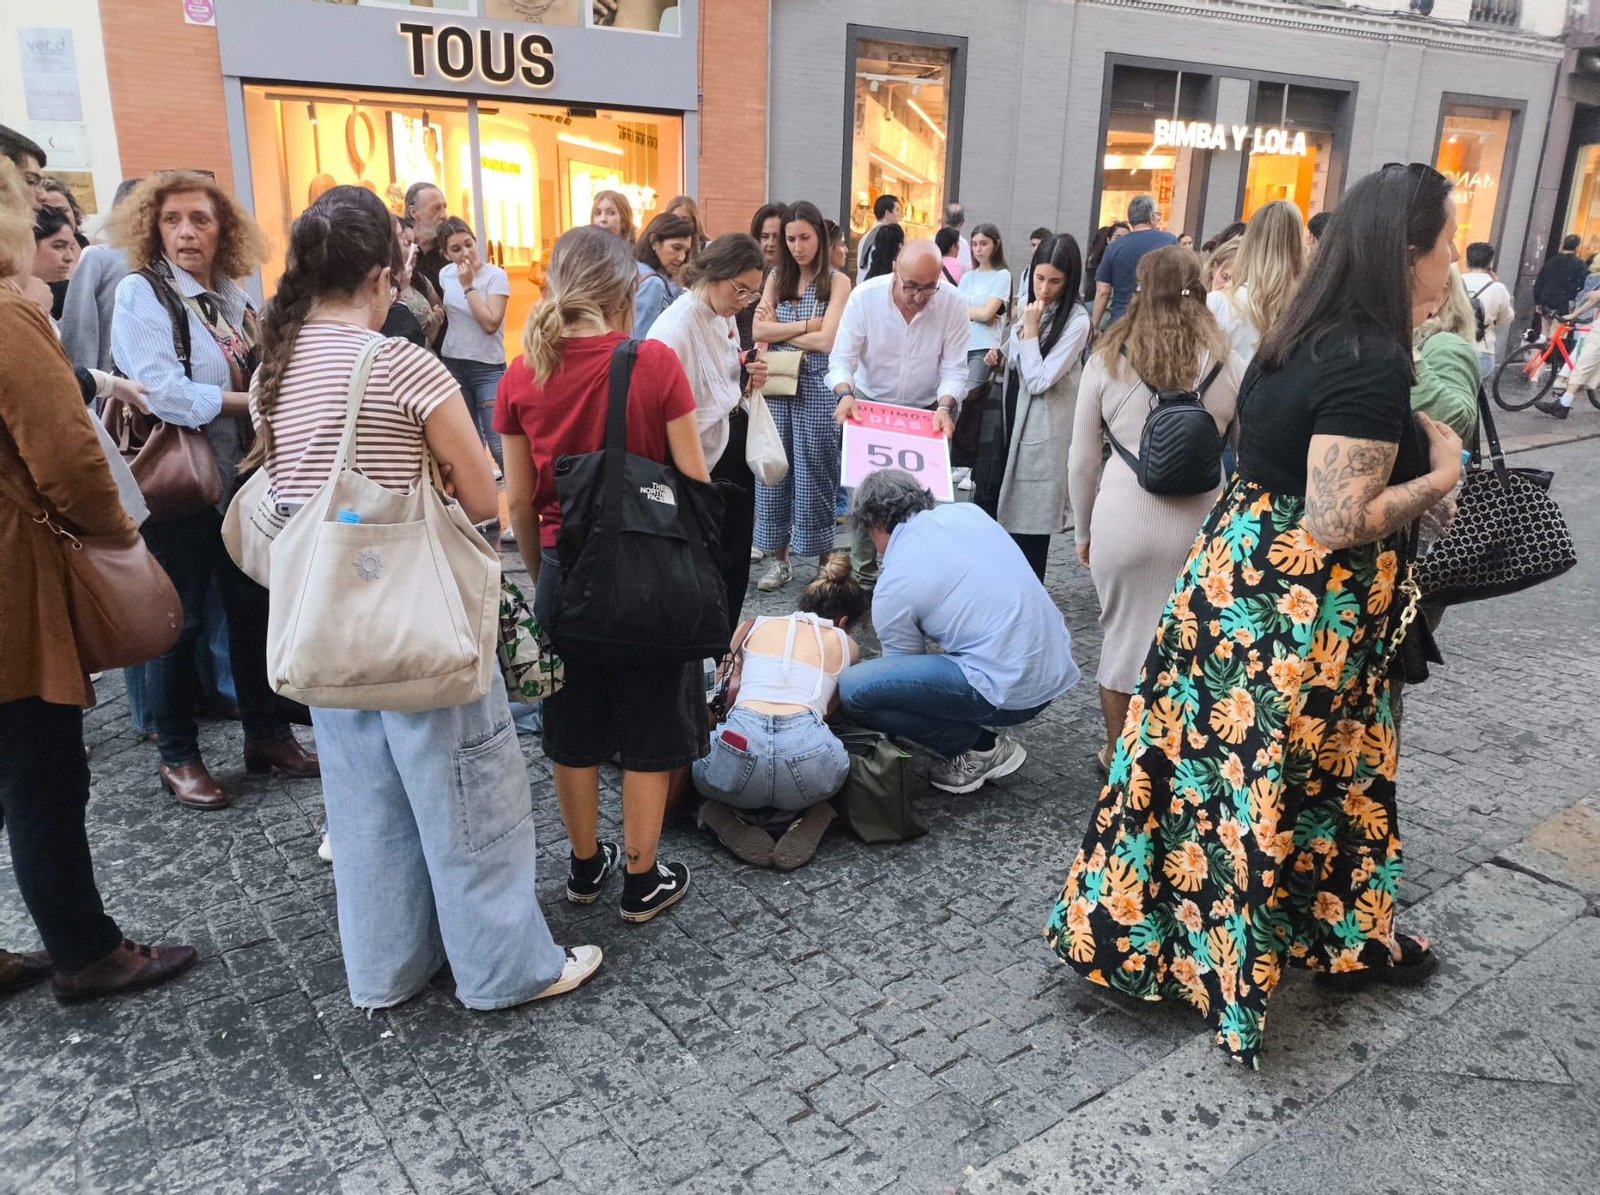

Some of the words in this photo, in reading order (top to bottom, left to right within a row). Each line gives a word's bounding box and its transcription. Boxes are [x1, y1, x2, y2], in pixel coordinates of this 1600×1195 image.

[399, 22, 555, 86] TOUS
[1154, 119, 1226, 150] BIMBA
[1232, 125, 1249, 151] Y
[1253, 127, 1307, 157] LOLA
[869, 415, 922, 429] DÍAS
[867, 443, 925, 473] 50
[640, 487, 665, 497] NORTH
[652, 482, 665, 491] THE
[647, 493, 665, 502] FACE
